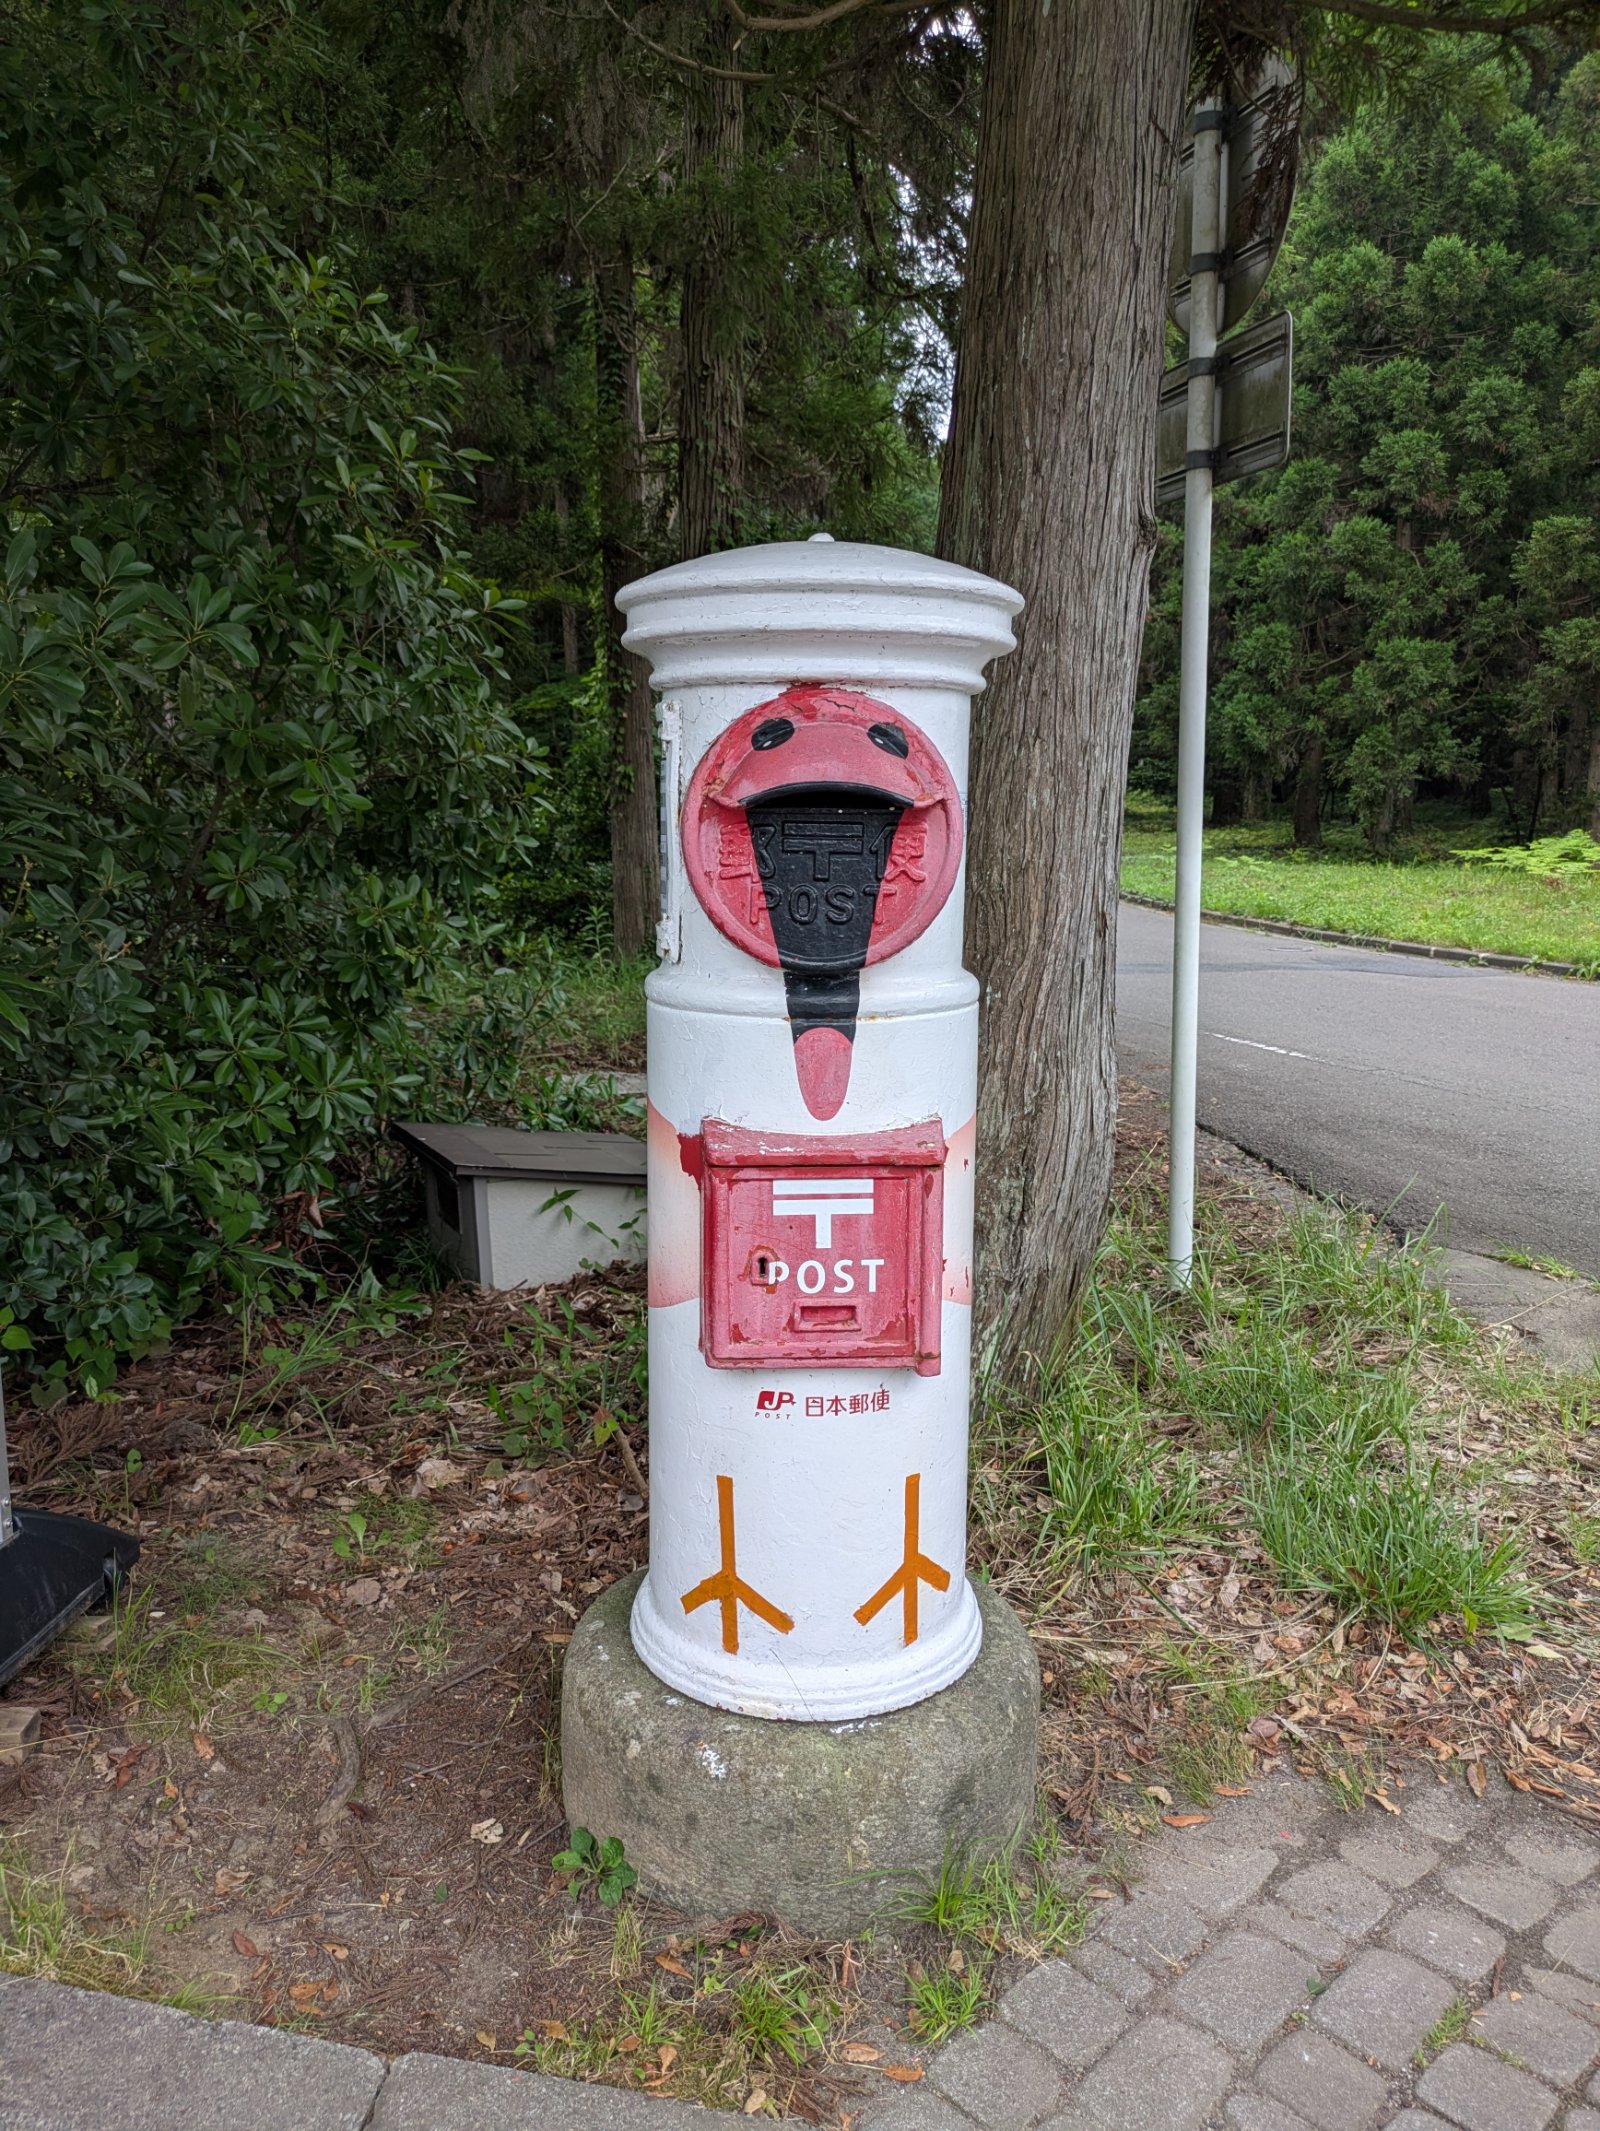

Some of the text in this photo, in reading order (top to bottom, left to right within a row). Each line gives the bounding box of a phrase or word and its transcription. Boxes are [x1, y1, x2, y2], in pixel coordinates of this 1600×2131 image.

[749, 884, 897, 925] POST
[768, 1259, 885, 1294] POST
[754, 1411, 791, 1420] POST
[805, 1389, 890, 1417] 日本郵便
